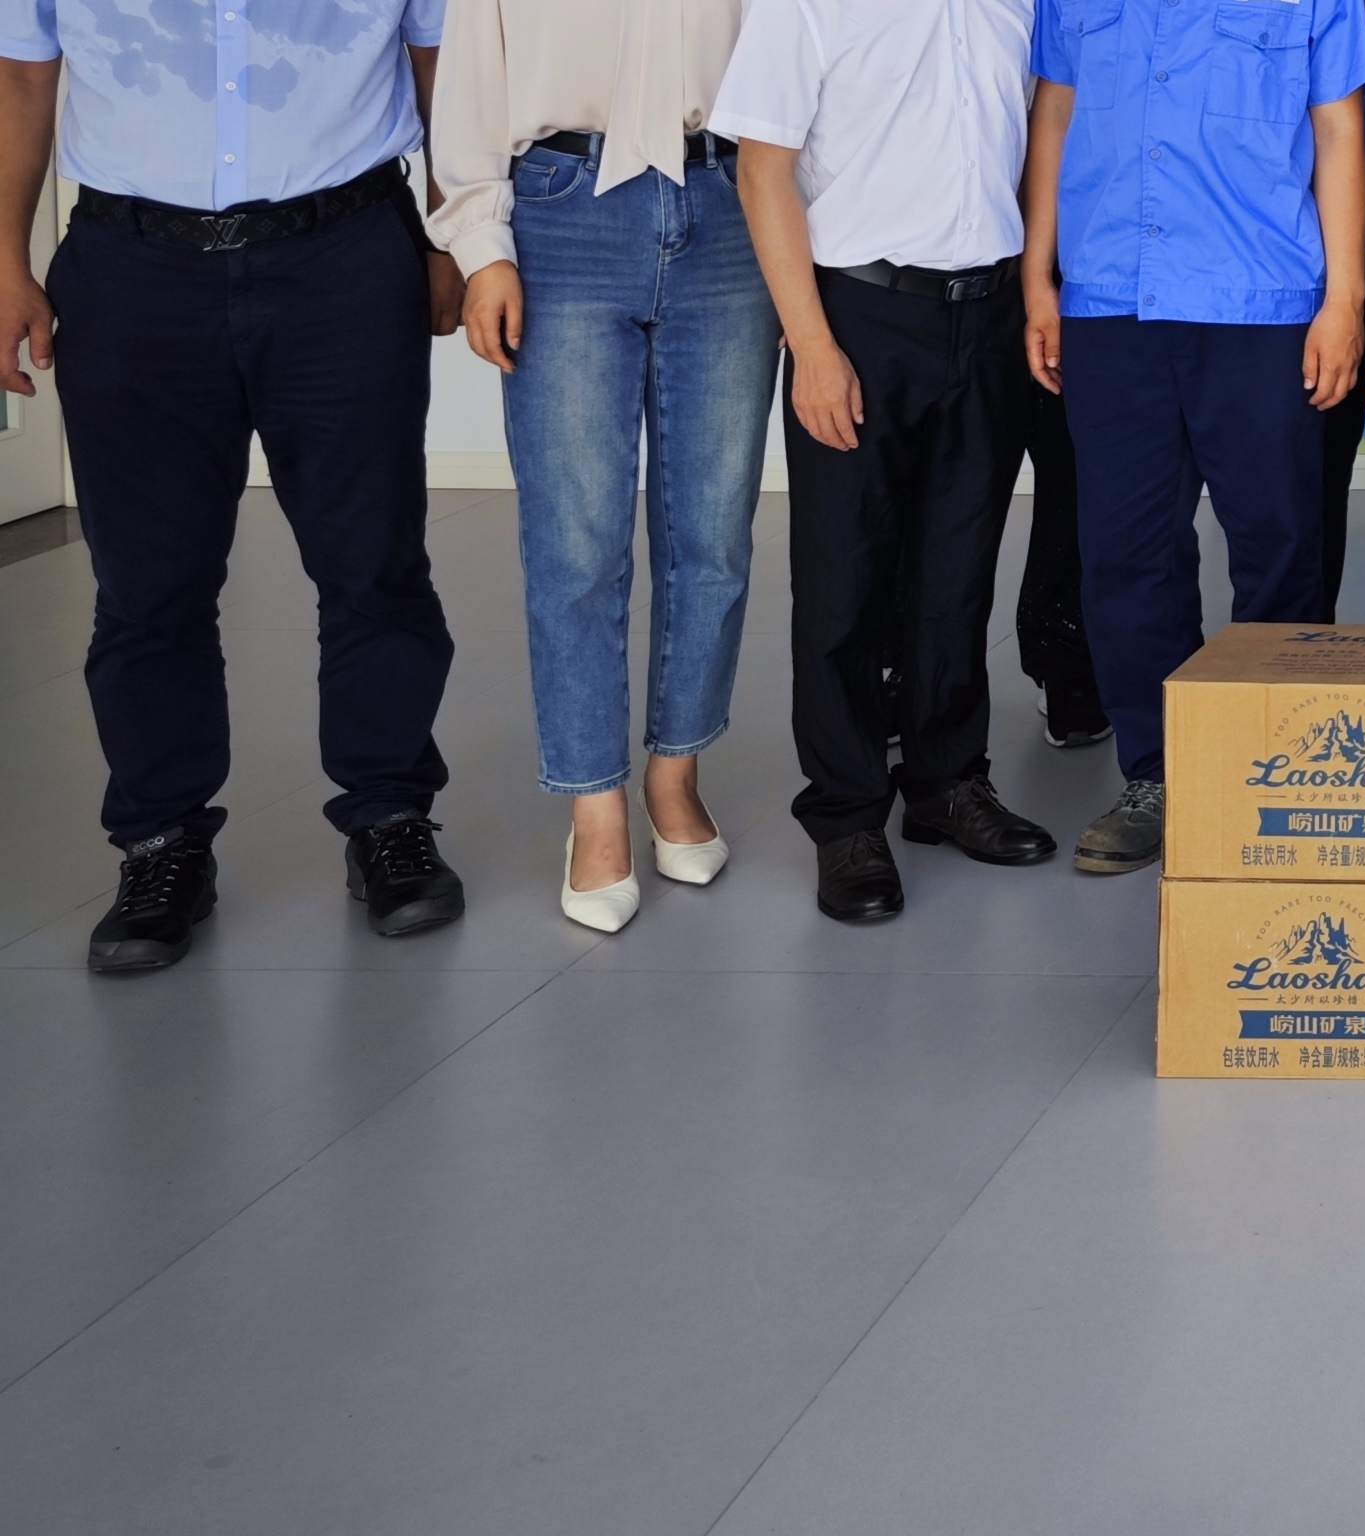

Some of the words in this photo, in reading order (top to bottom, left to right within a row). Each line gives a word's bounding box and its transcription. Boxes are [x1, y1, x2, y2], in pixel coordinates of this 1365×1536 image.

[1275, 717, 1290, 738] TOO
[1293, 696, 1318, 714] RARE
[1326, 693, 1349, 701] TOO
[1241, 844, 1297, 866] 包装饮用水
[1256, 921, 1271, 940] TOO
[1275, 898, 1301, 916] RARE
[1223, 1046, 1279, 1068] 包装饮用水
